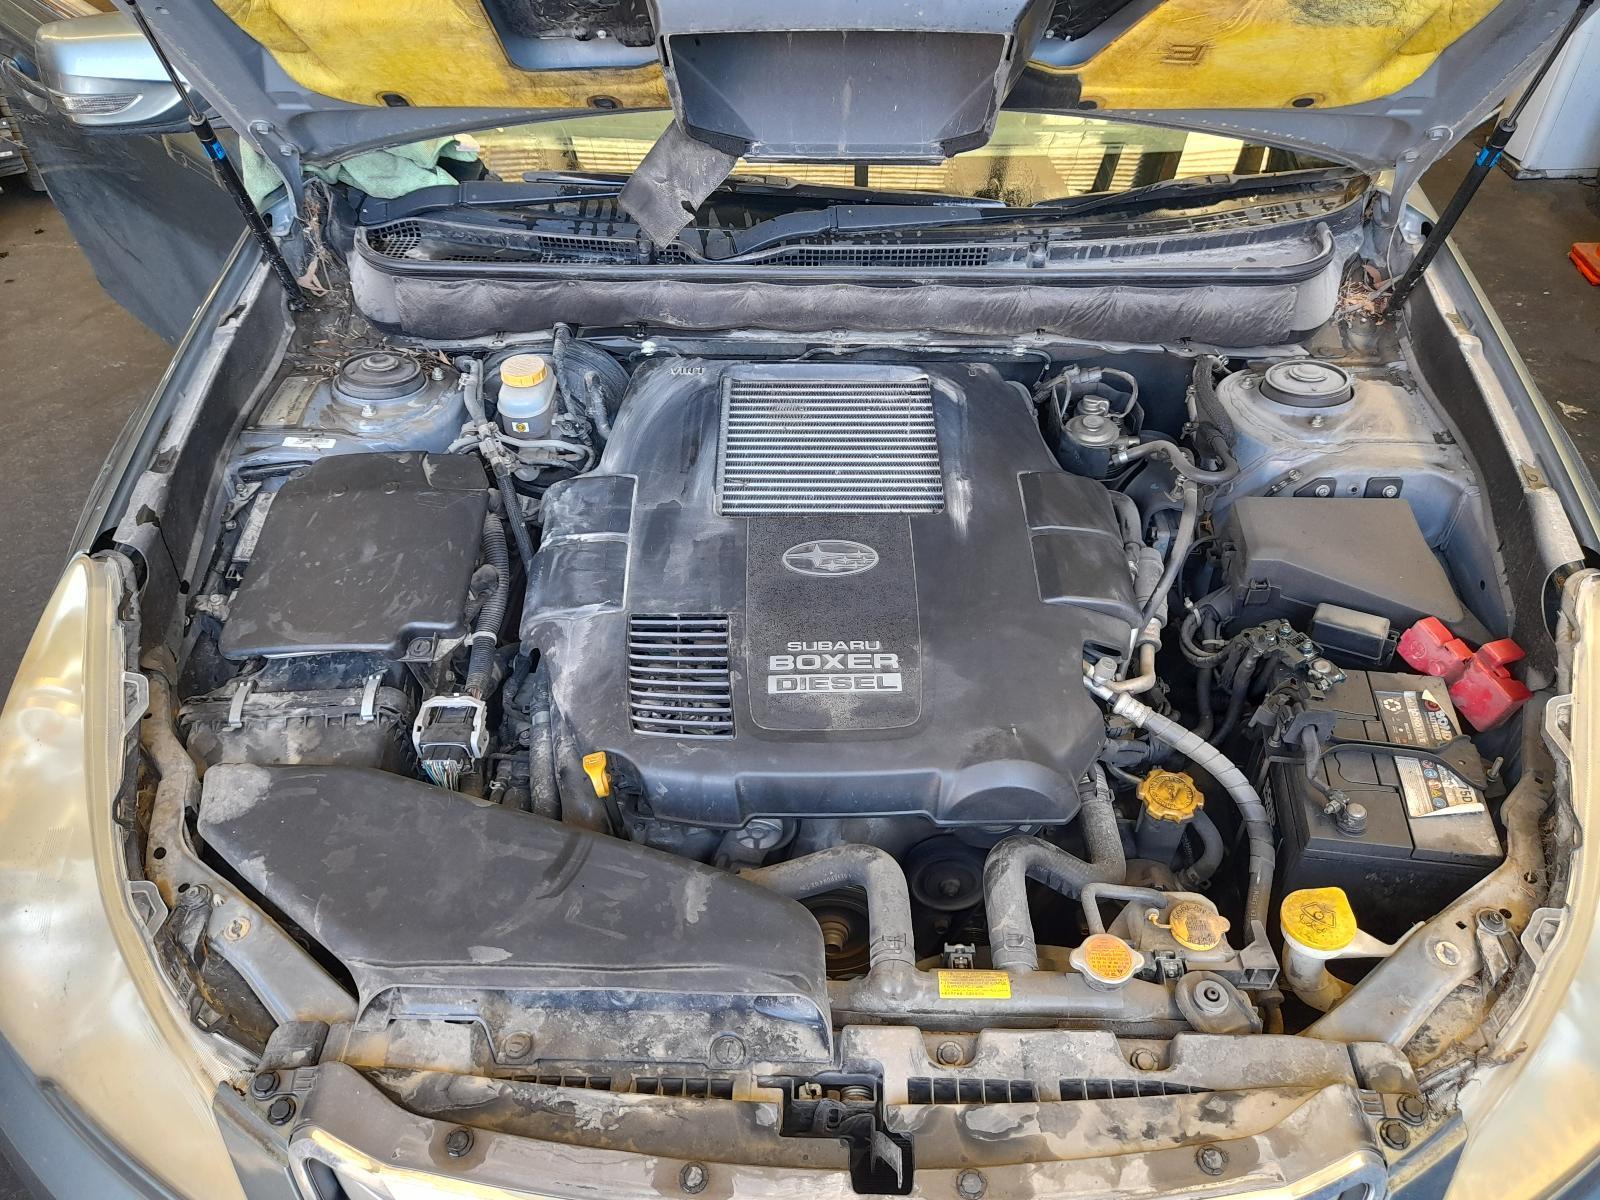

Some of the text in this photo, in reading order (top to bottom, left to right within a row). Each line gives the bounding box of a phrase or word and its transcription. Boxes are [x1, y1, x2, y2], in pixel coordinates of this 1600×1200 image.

[787, 640, 880, 651] SUBARU
[769, 653, 899, 671] BOXER
[776, 675, 898, 691] DIESEL
[1407, 696, 1427, 744] AUTOMOTIVE
